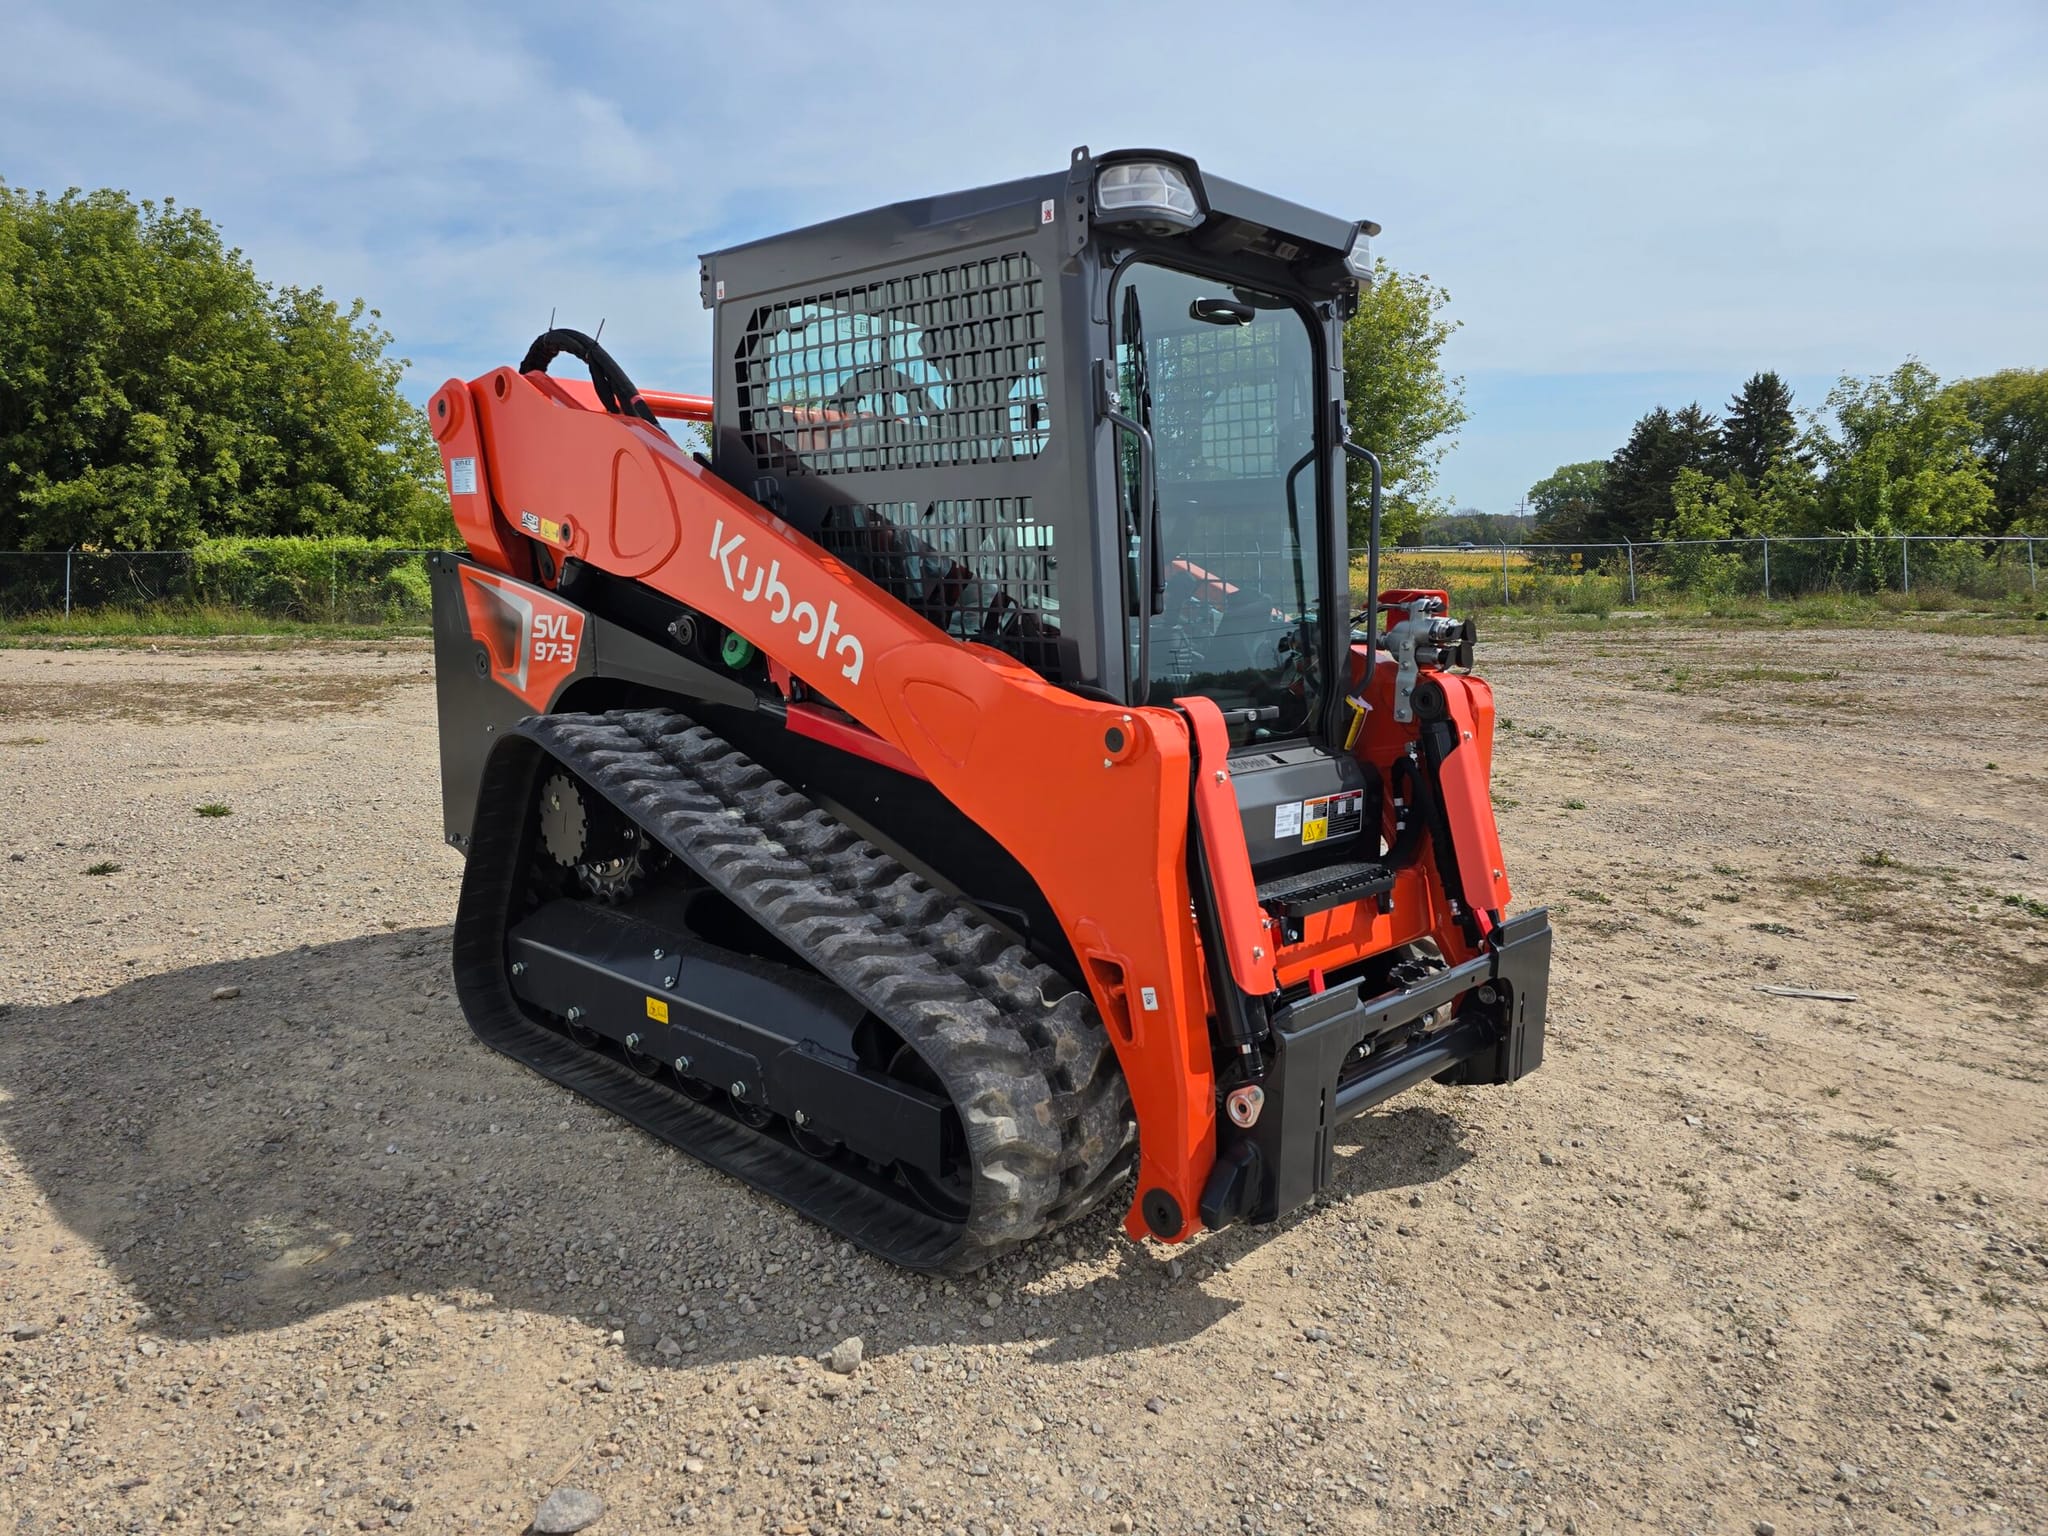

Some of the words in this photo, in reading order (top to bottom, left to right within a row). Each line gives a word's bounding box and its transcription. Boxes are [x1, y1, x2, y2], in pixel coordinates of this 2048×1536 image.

[709, 519, 864, 686] Kubota
[532, 614, 576, 641] SVL
[534, 641, 573, 663] 97-3
